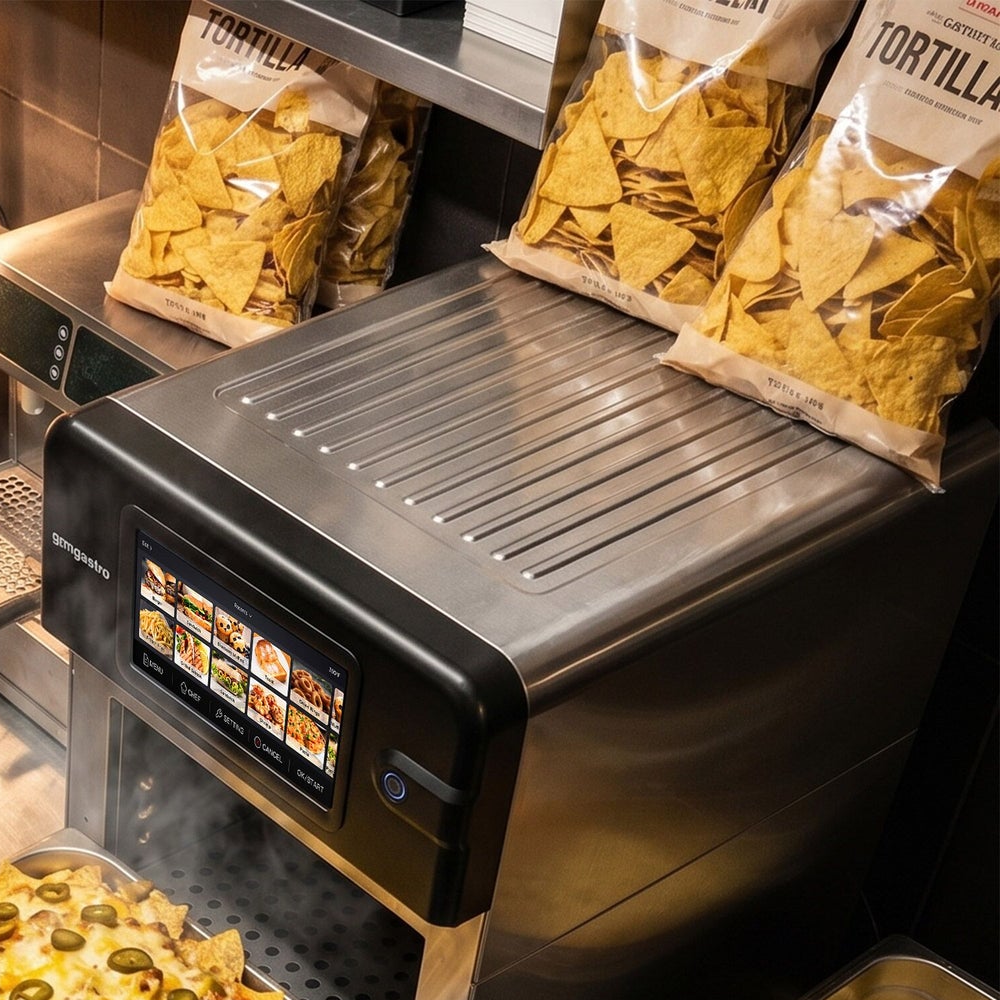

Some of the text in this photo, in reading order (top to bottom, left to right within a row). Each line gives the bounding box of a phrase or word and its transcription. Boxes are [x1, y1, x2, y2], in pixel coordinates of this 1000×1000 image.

[200, 8, 312, 72] TORTILLA
[149, 659, 164, 675] MENU
[187, 688, 202, 702] CHEF
[261, 743, 283, 764] CANCEL
